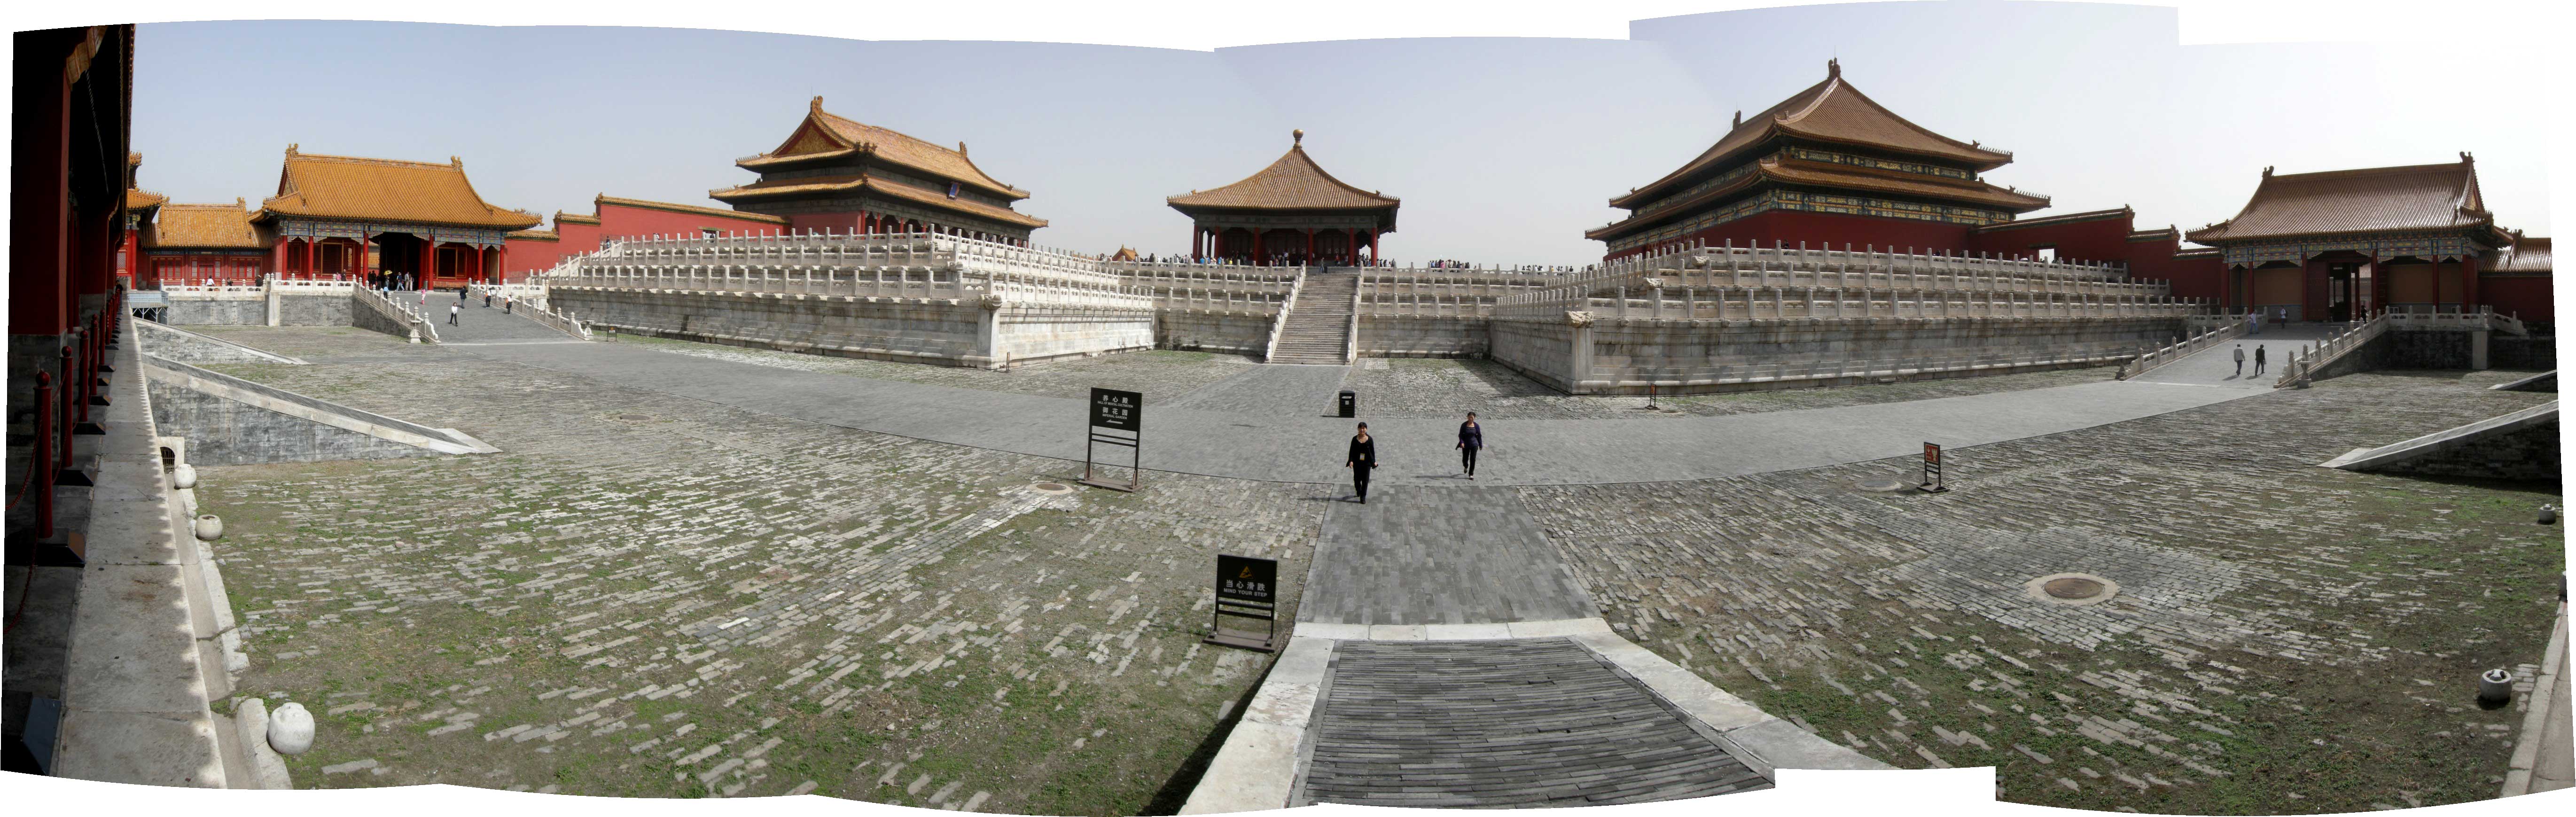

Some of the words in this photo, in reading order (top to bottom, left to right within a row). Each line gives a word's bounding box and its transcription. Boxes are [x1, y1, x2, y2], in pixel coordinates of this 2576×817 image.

[1102, 395, 1128, 404] 养心殿
[1102, 407, 1128, 416] 御花园
[1226, 579, 1265, 591] 当心滑跌
